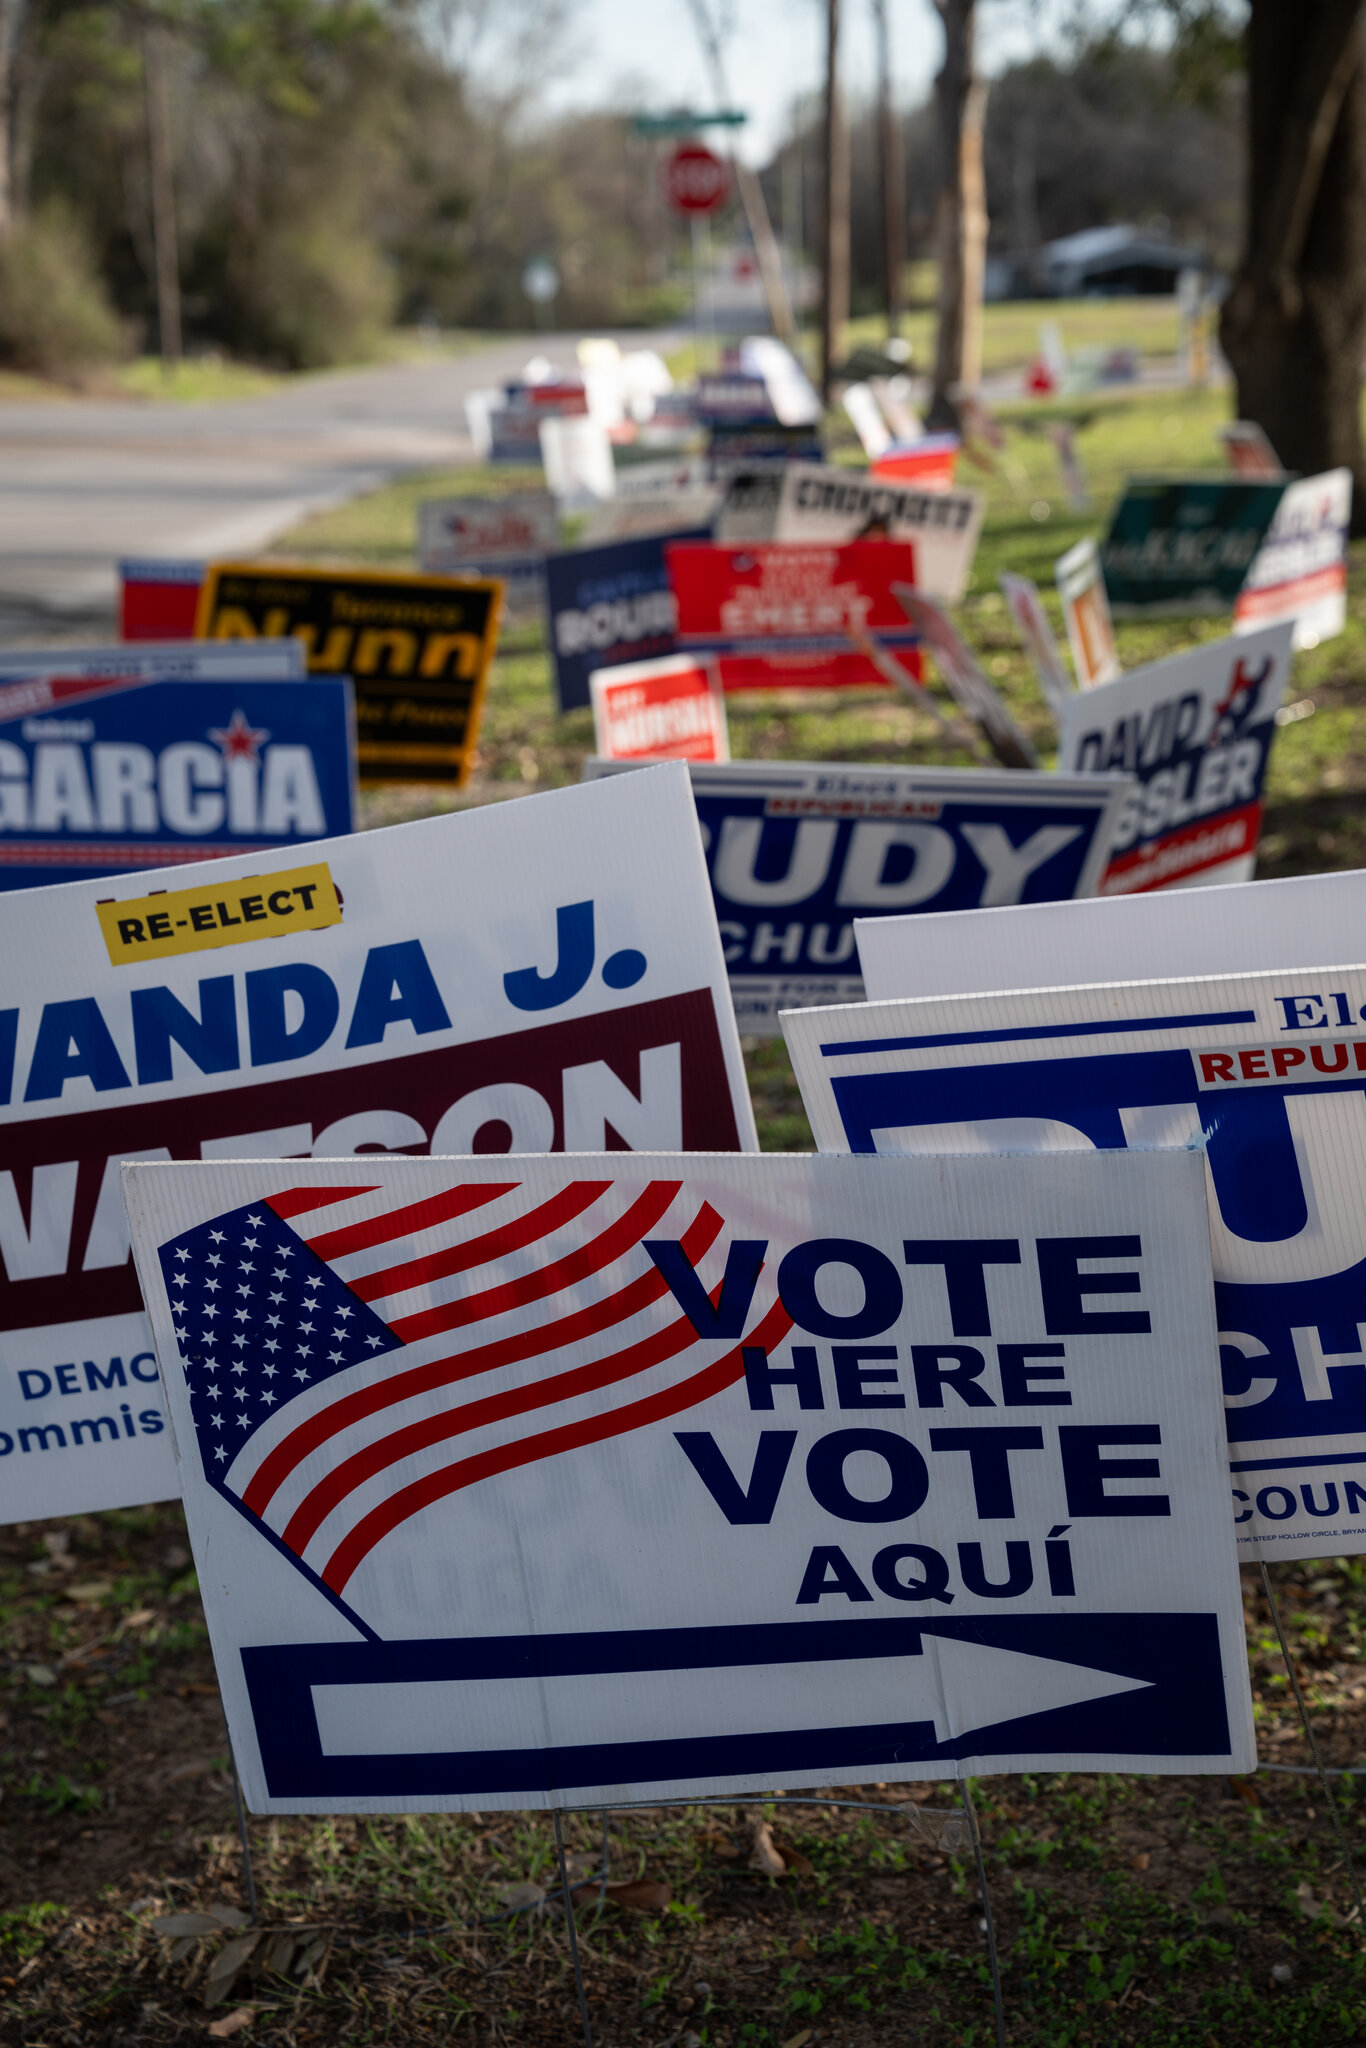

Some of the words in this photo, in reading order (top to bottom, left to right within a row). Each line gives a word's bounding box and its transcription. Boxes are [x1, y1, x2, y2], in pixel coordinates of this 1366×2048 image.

[1077, 692, 1203, 772] DAVID
[700, 816, 1084, 908] UDY
[117, 883, 317, 944] RE-ELECT
[0, 939, 453, 1106] ANDA
[503, 899, 648, 1012] J.
[1274, 992, 1366, 1030] El
[0, 1042, 681, 1282] WON
[870, 1090, 1366, 1285] U
[641, 1235, 1152, 1340] VOTE
[17, 1352, 160, 1401] DEMO
[741, 1343, 1073, 1411] HERE
[672, 1424, 1172, 1525] VOTE
[795, 1524, 1076, 1605] AQUÍ
[1278, 1532, 1310, 1540] HOLLOW
[1311, 1529, 1341, 1537] CIRCLE,
